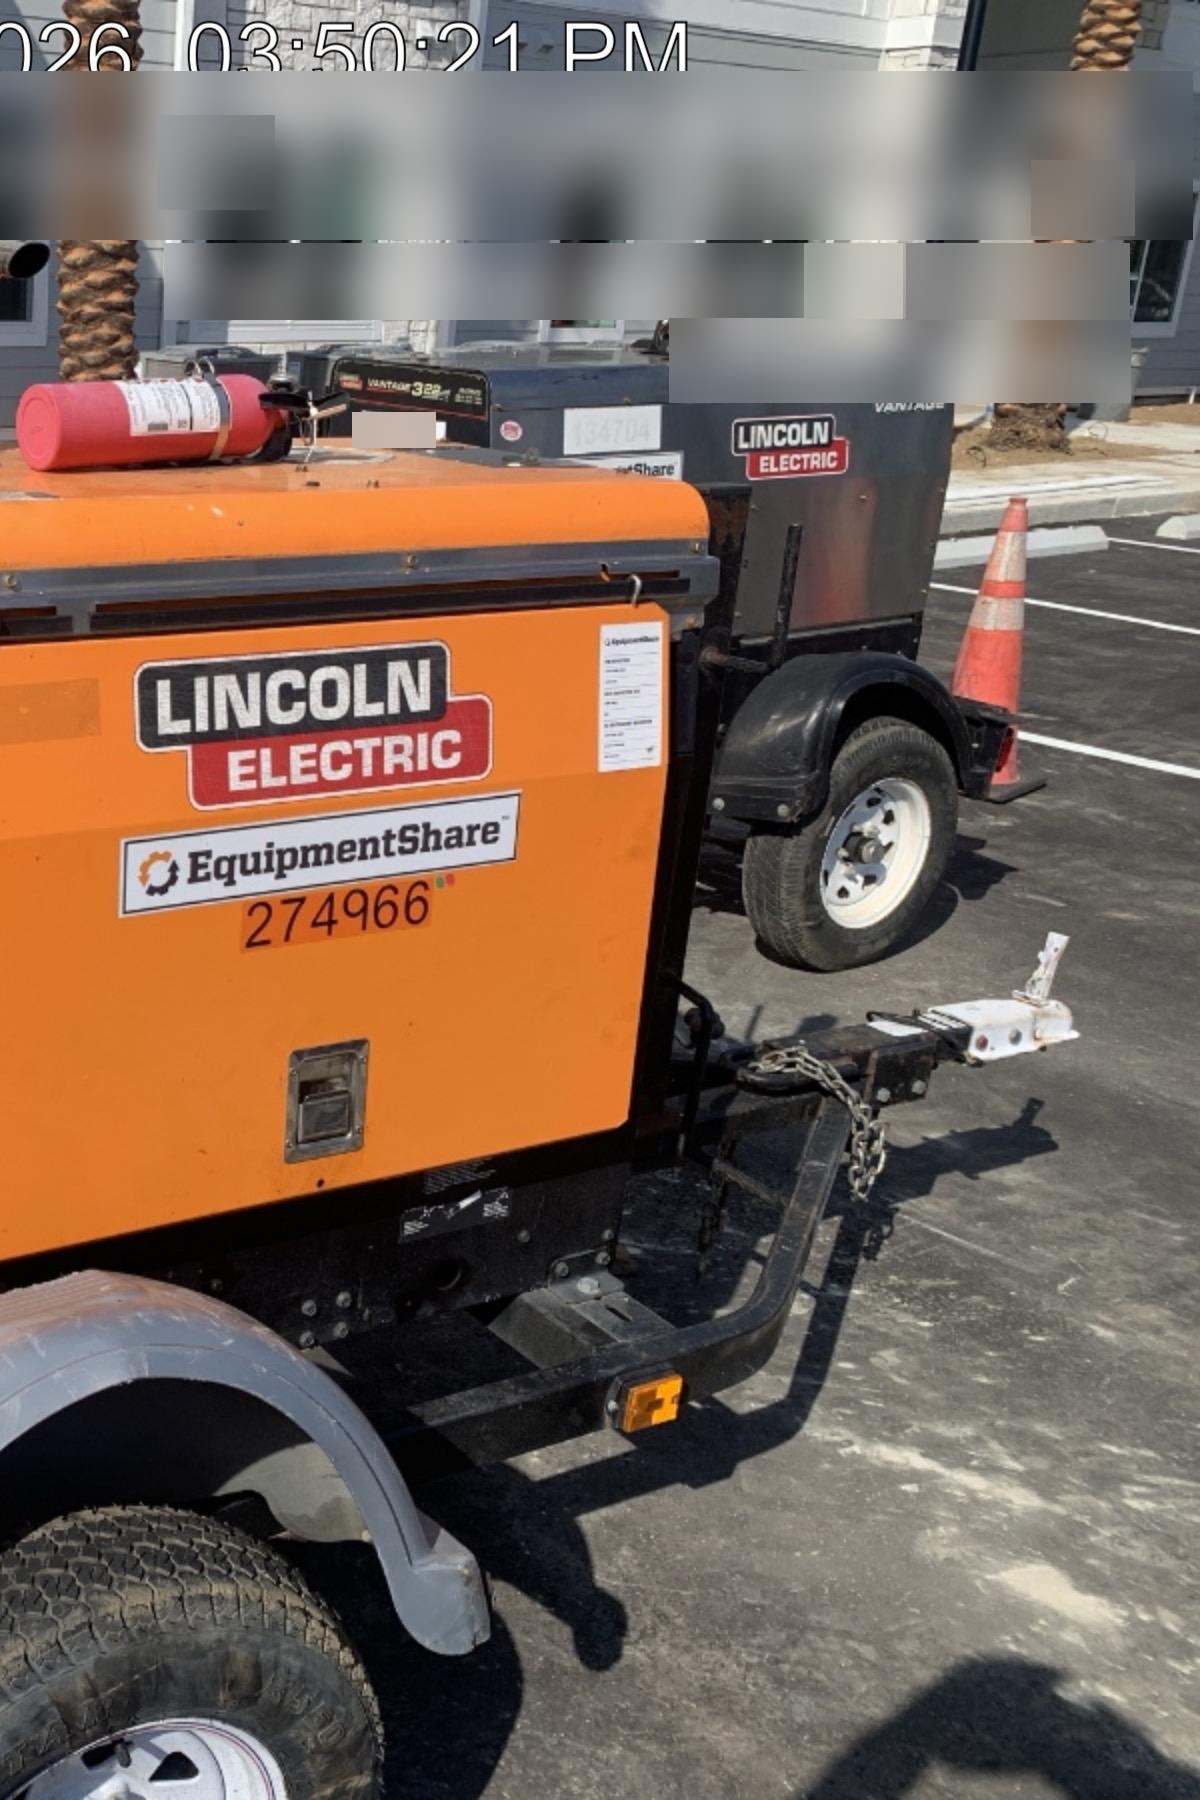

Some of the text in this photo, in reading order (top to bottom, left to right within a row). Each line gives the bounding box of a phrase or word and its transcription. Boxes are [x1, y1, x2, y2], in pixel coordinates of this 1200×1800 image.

[573, 418, 650, 447] 134704
[738, 421, 831, 449] LINCOLN
[758, 451, 838, 474] ELECTRIC
[155, 658, 432, 736] LINCOLN
[227, 729, 463, 792] ELECTRIC
[186, 821, 502, 888] EquipmentShare
[244, 879, 431, 949] 274966
